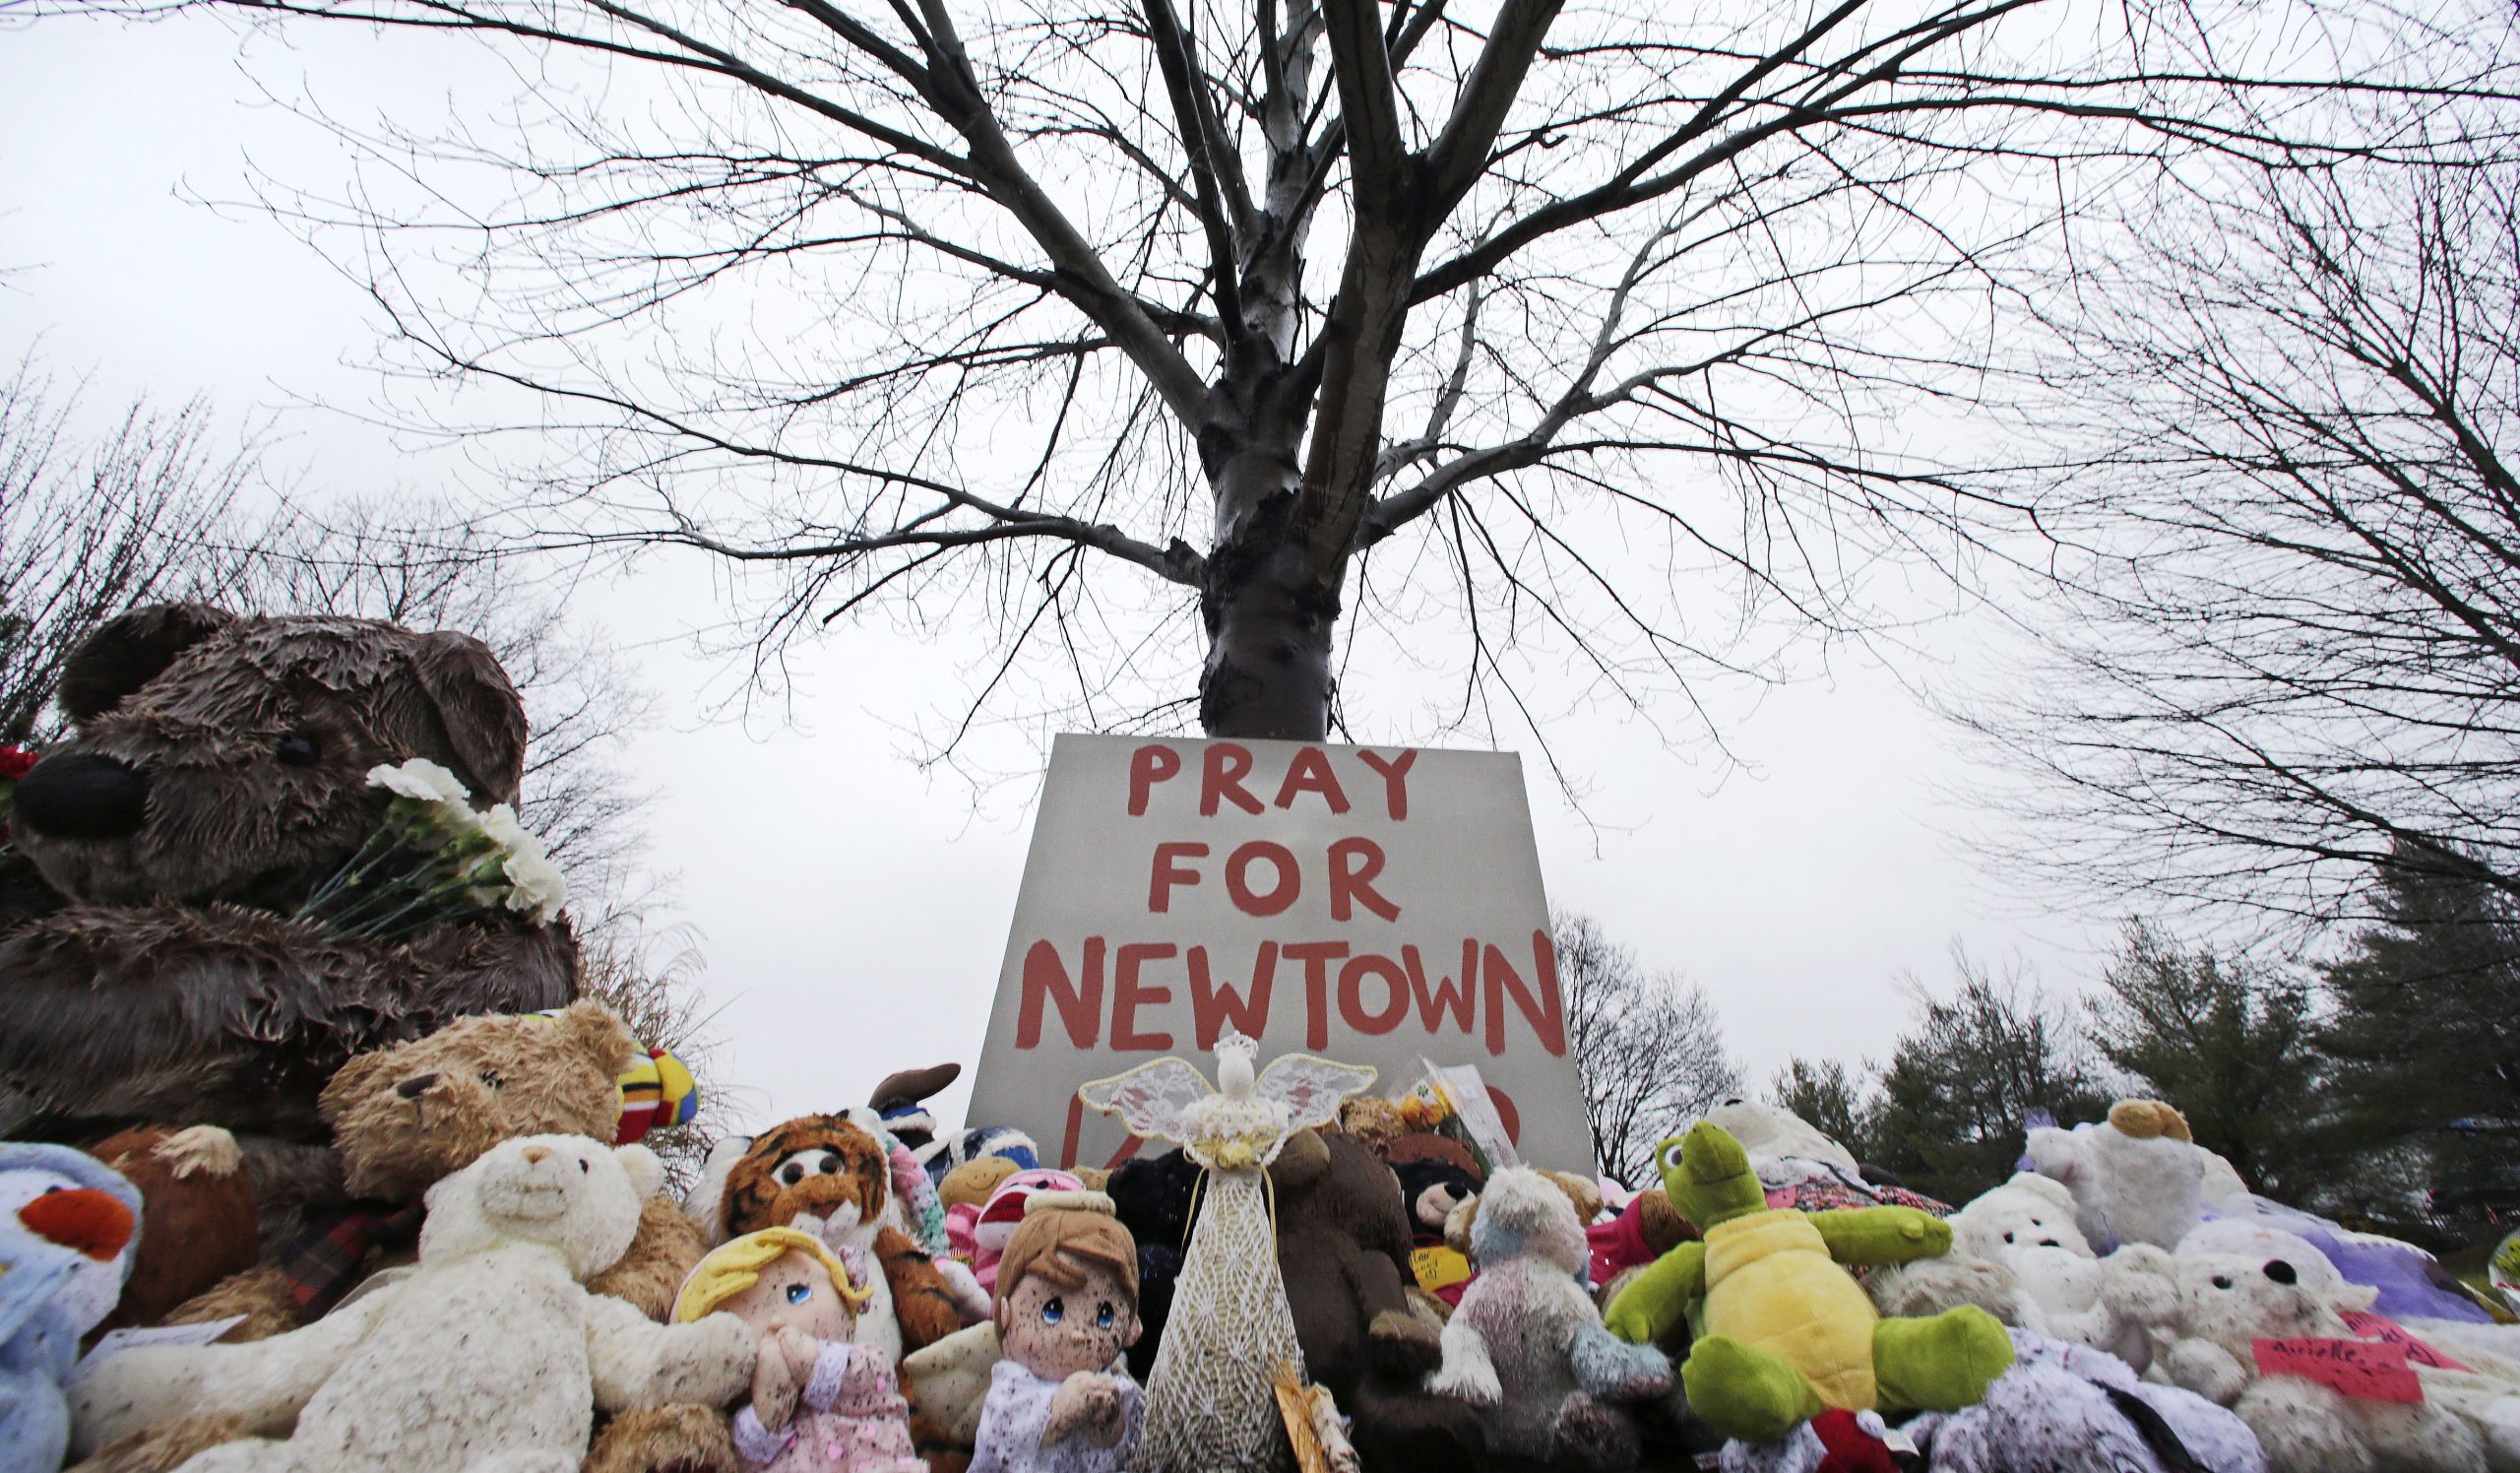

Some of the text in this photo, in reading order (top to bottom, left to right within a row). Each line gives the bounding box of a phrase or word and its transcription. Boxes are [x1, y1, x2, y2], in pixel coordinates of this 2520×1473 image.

[1128, 742, 1418, 821] PRAY
[1149, 837, 1400, 923] FOR
[1015, 929, 1566, 1057] NEWTOWN
